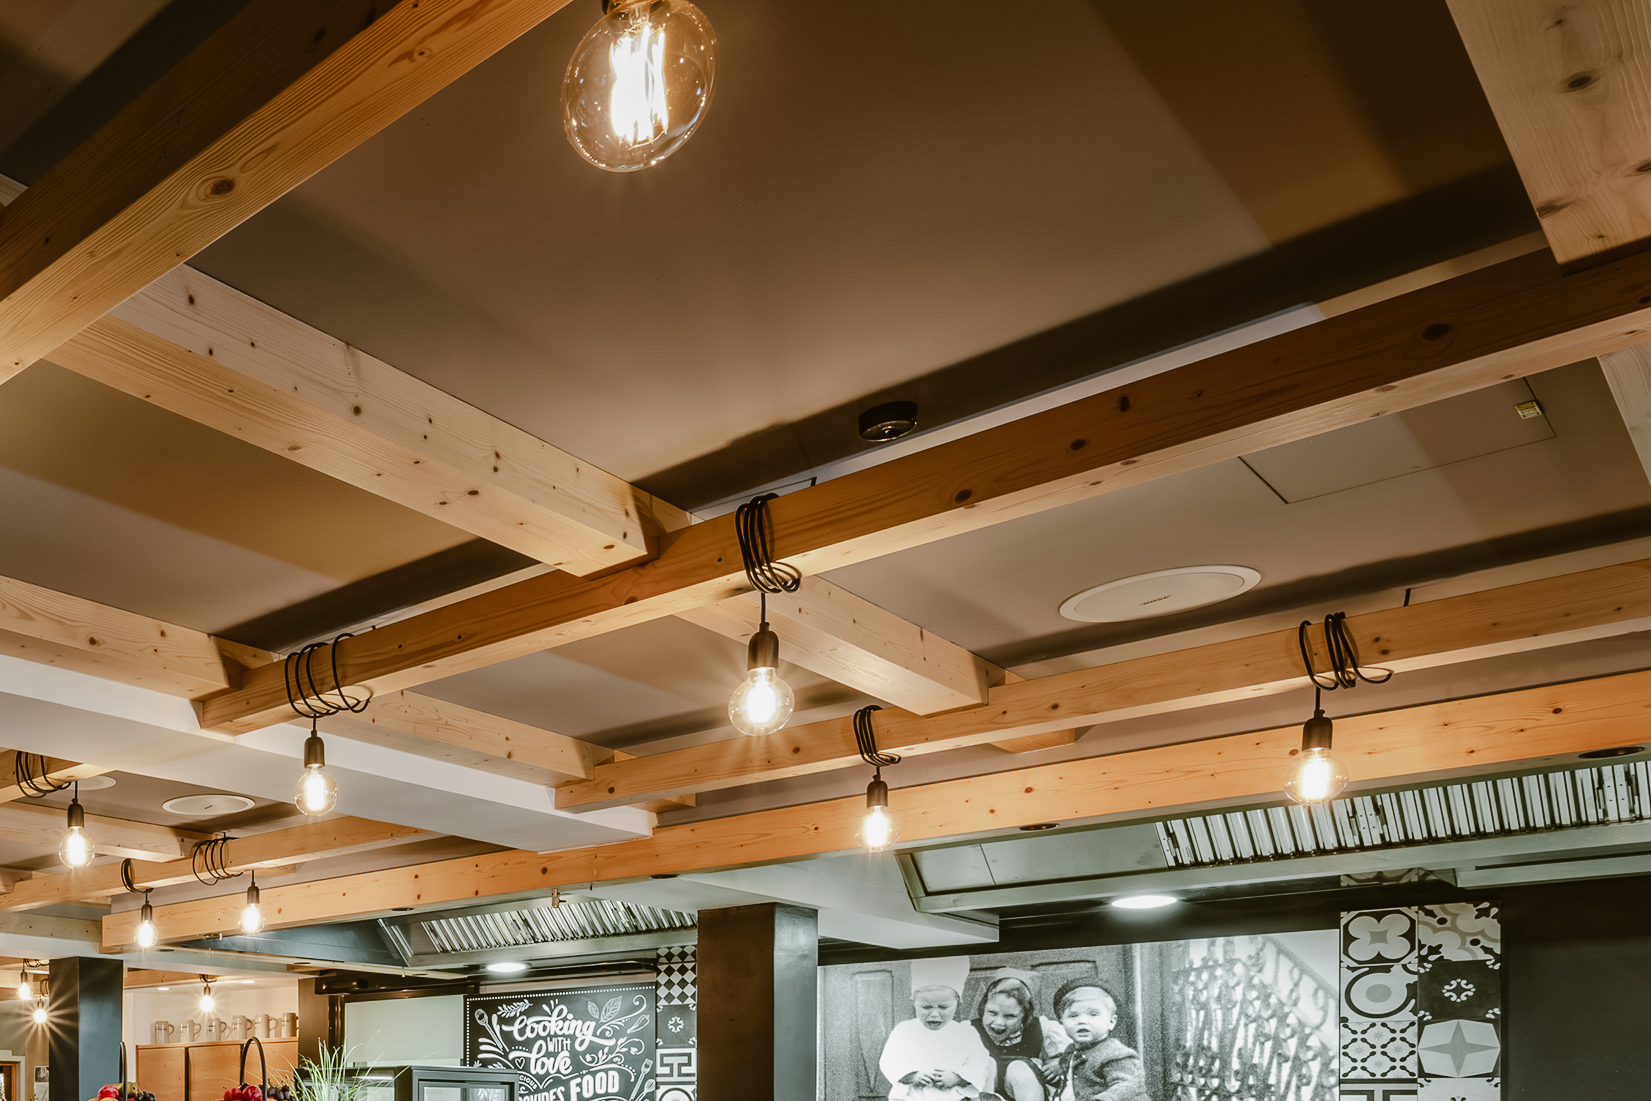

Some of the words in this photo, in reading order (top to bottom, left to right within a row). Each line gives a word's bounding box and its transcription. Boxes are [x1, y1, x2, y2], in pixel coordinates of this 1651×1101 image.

[502, 1004, 616, 1052] Cooking
[546, 1037, 572, 1052] WITH
[508, 1040, 573, 1075] love
